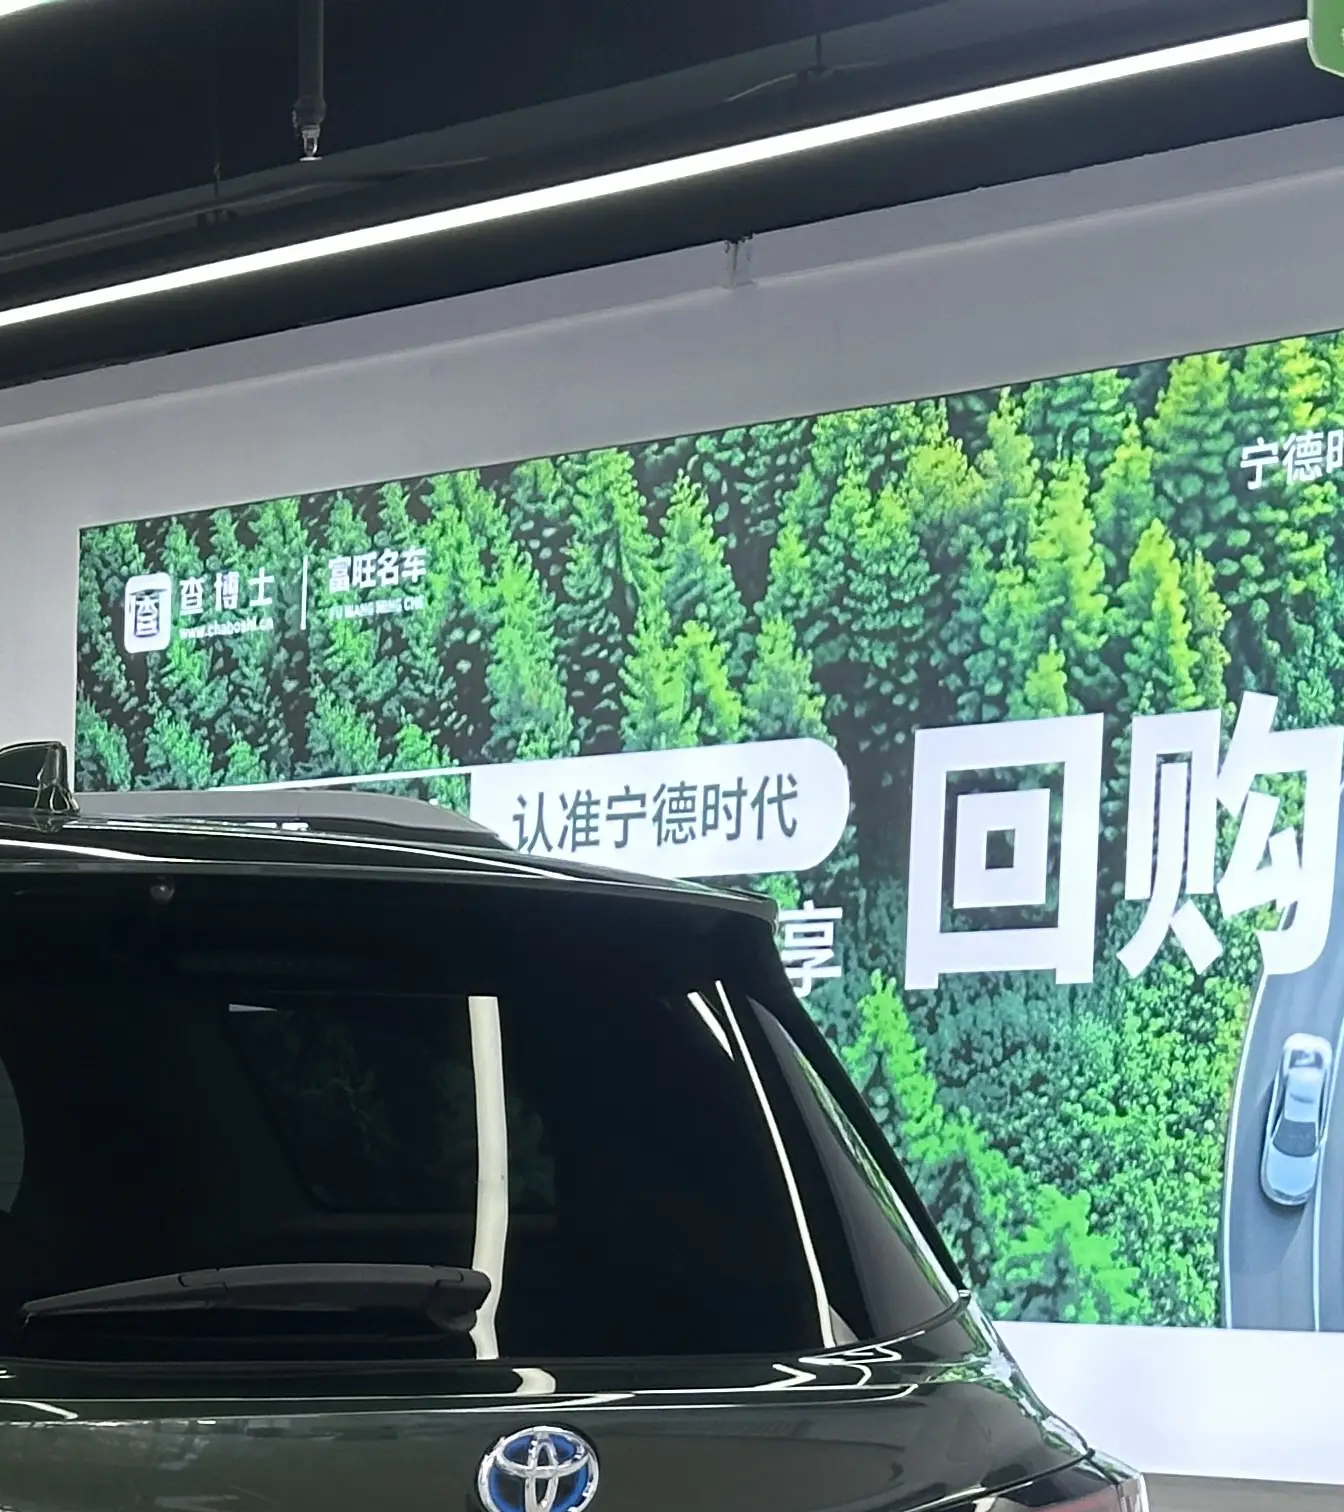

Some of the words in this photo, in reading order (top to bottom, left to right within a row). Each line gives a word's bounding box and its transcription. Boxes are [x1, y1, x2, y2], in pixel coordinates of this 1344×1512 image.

[328, 546, 427, 593] 富旺名车
[512, 773, 799, 855] 认准宁德时代
[904, 690, 1344, 991] 回购
[778, 899, 843, 999] 享
